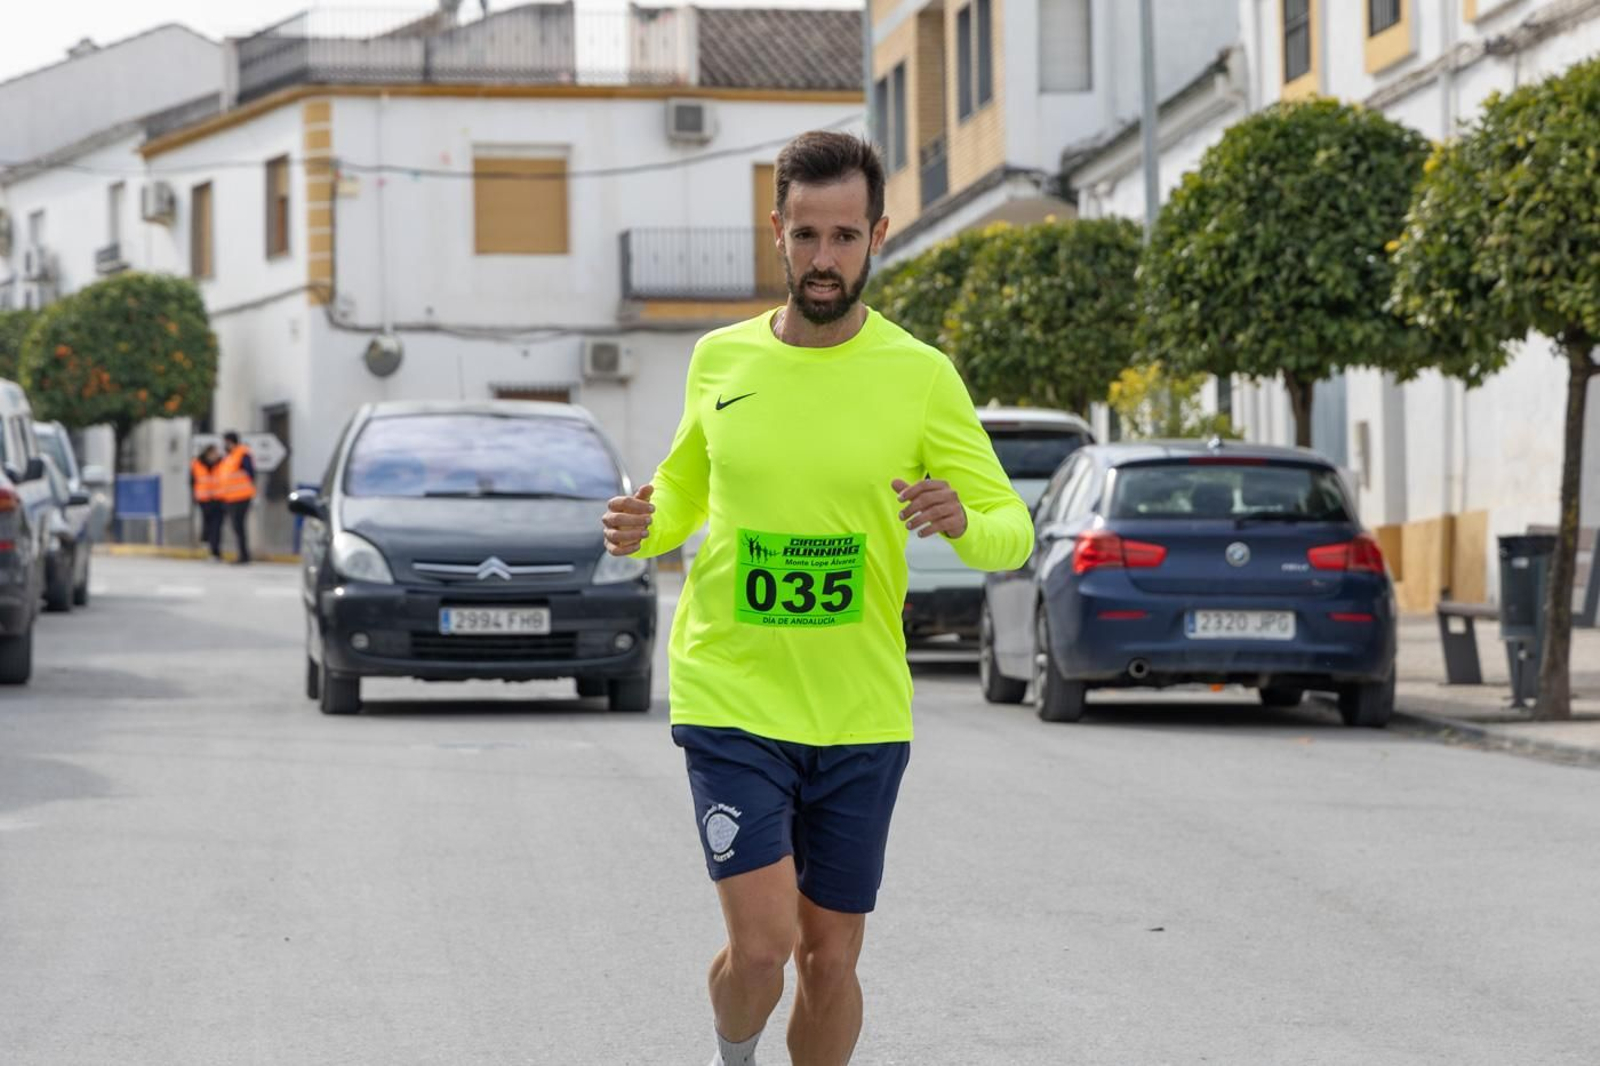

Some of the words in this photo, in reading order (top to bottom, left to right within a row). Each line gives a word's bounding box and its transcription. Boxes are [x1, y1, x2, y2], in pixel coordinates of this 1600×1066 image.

[789, 537, 854, 546] CIRCUITO
[782, 545, 860, 556] RUNNING
[811, 559, 829, 567] Lope
[830, 556, 856, 566] Álvarez
[746, 568, 853, 614] 035
[454, 610, 502, 630] 2994
[762, 616, 776, 624] DÍA
[778, 617, 788, 625] DE
[790, 616, 836, 625] ANDALUCÍA
[1200, 612, 1249, 633] 2320
[1253, 612, 1291, 633] JPG
